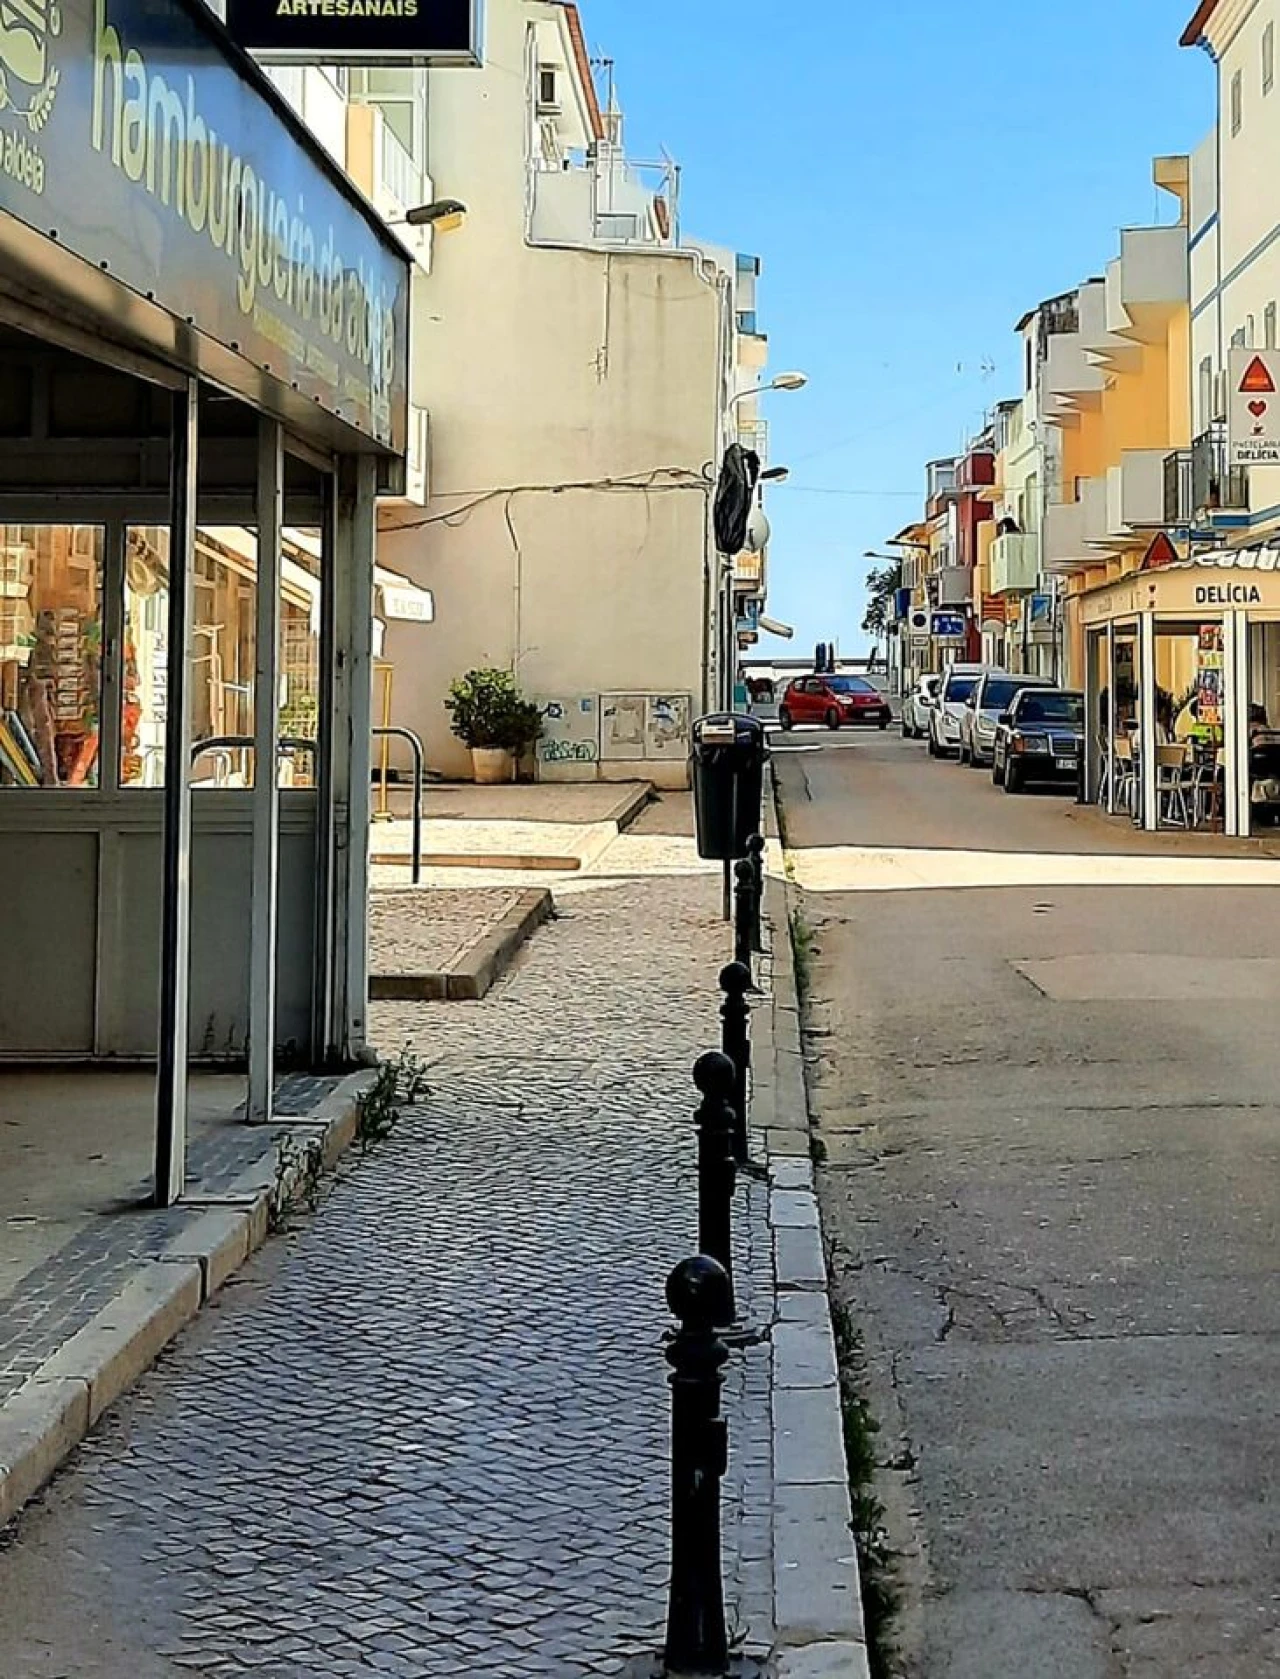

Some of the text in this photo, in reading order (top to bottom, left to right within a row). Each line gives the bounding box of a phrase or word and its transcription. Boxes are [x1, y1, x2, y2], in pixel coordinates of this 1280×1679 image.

[276, 0, 418, 17] ARTESANAIS
[94, 0, 314, 316] hamburgueria
[320, 223, 344, 344] da
[1195, 582, 1260, 603] DELÍCIA
